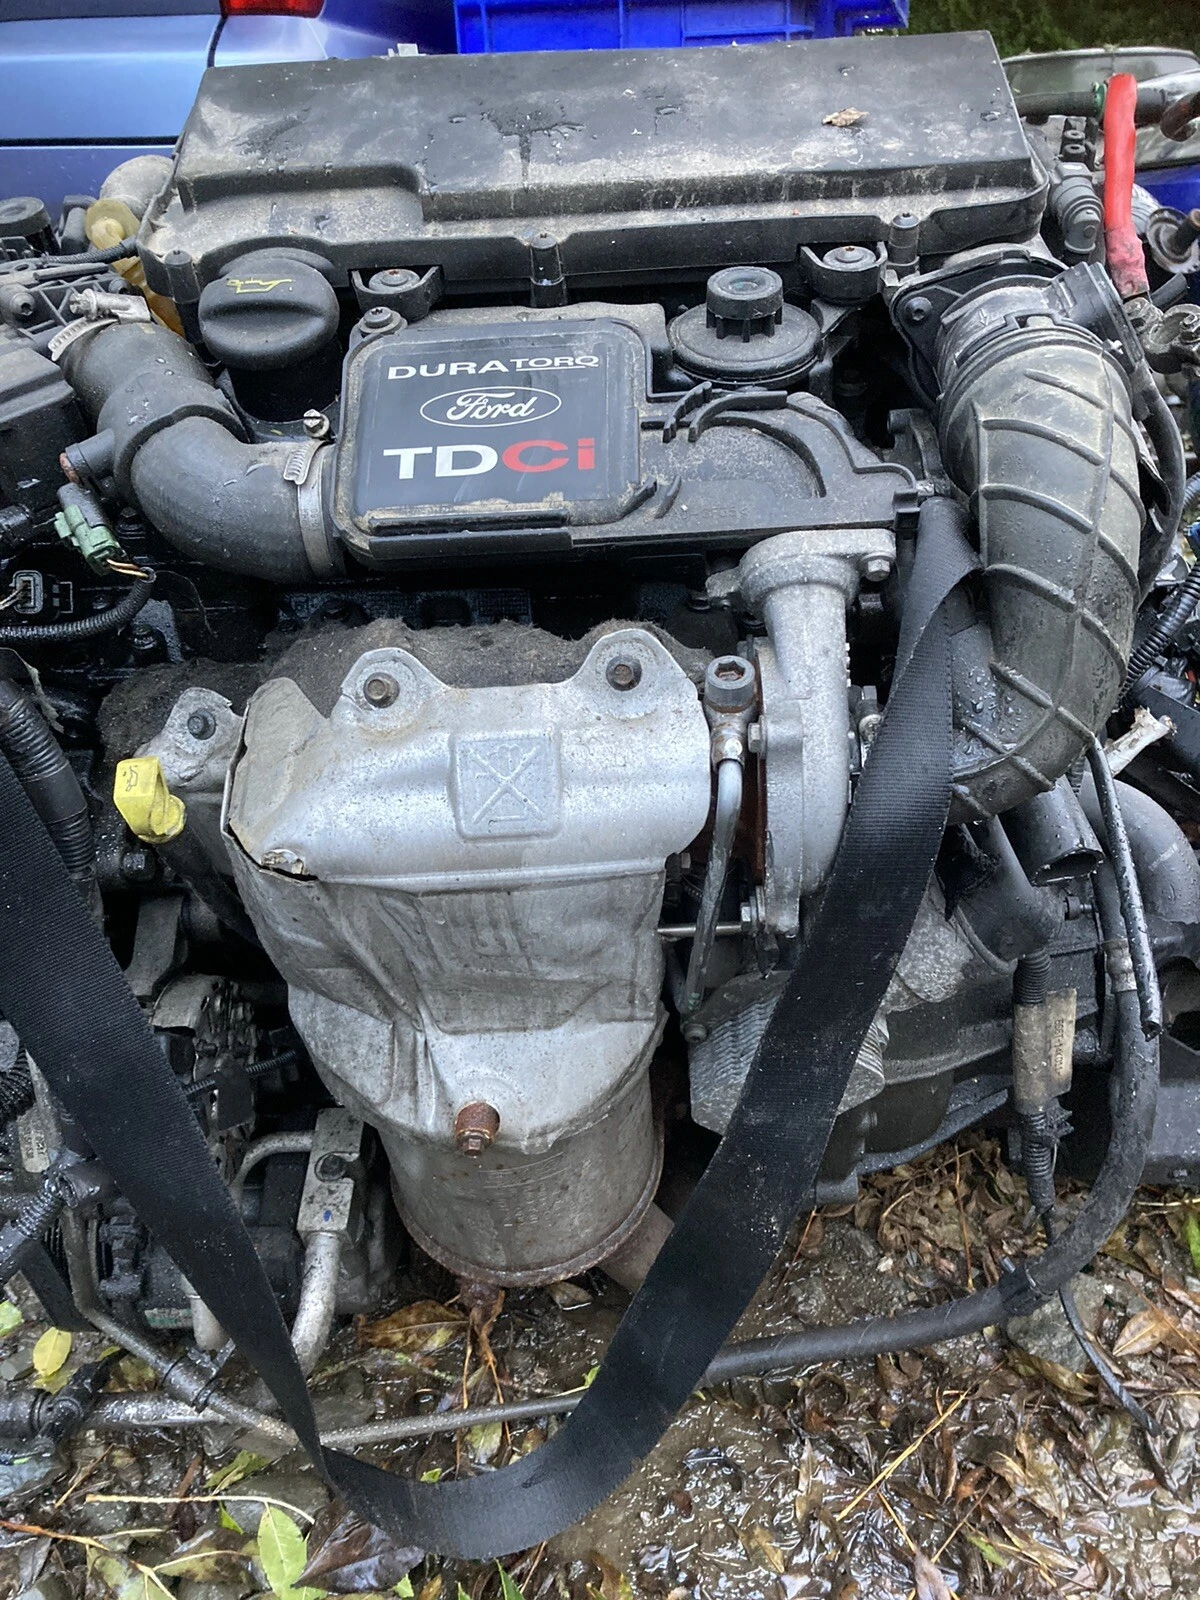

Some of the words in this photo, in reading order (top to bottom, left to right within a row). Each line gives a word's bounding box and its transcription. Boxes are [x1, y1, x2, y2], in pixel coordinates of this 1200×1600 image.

[388, 355, 600, 380] DURATORQ
[446, 391, 539, 421] Ford
[383, 437, 596, 480] TDCi
